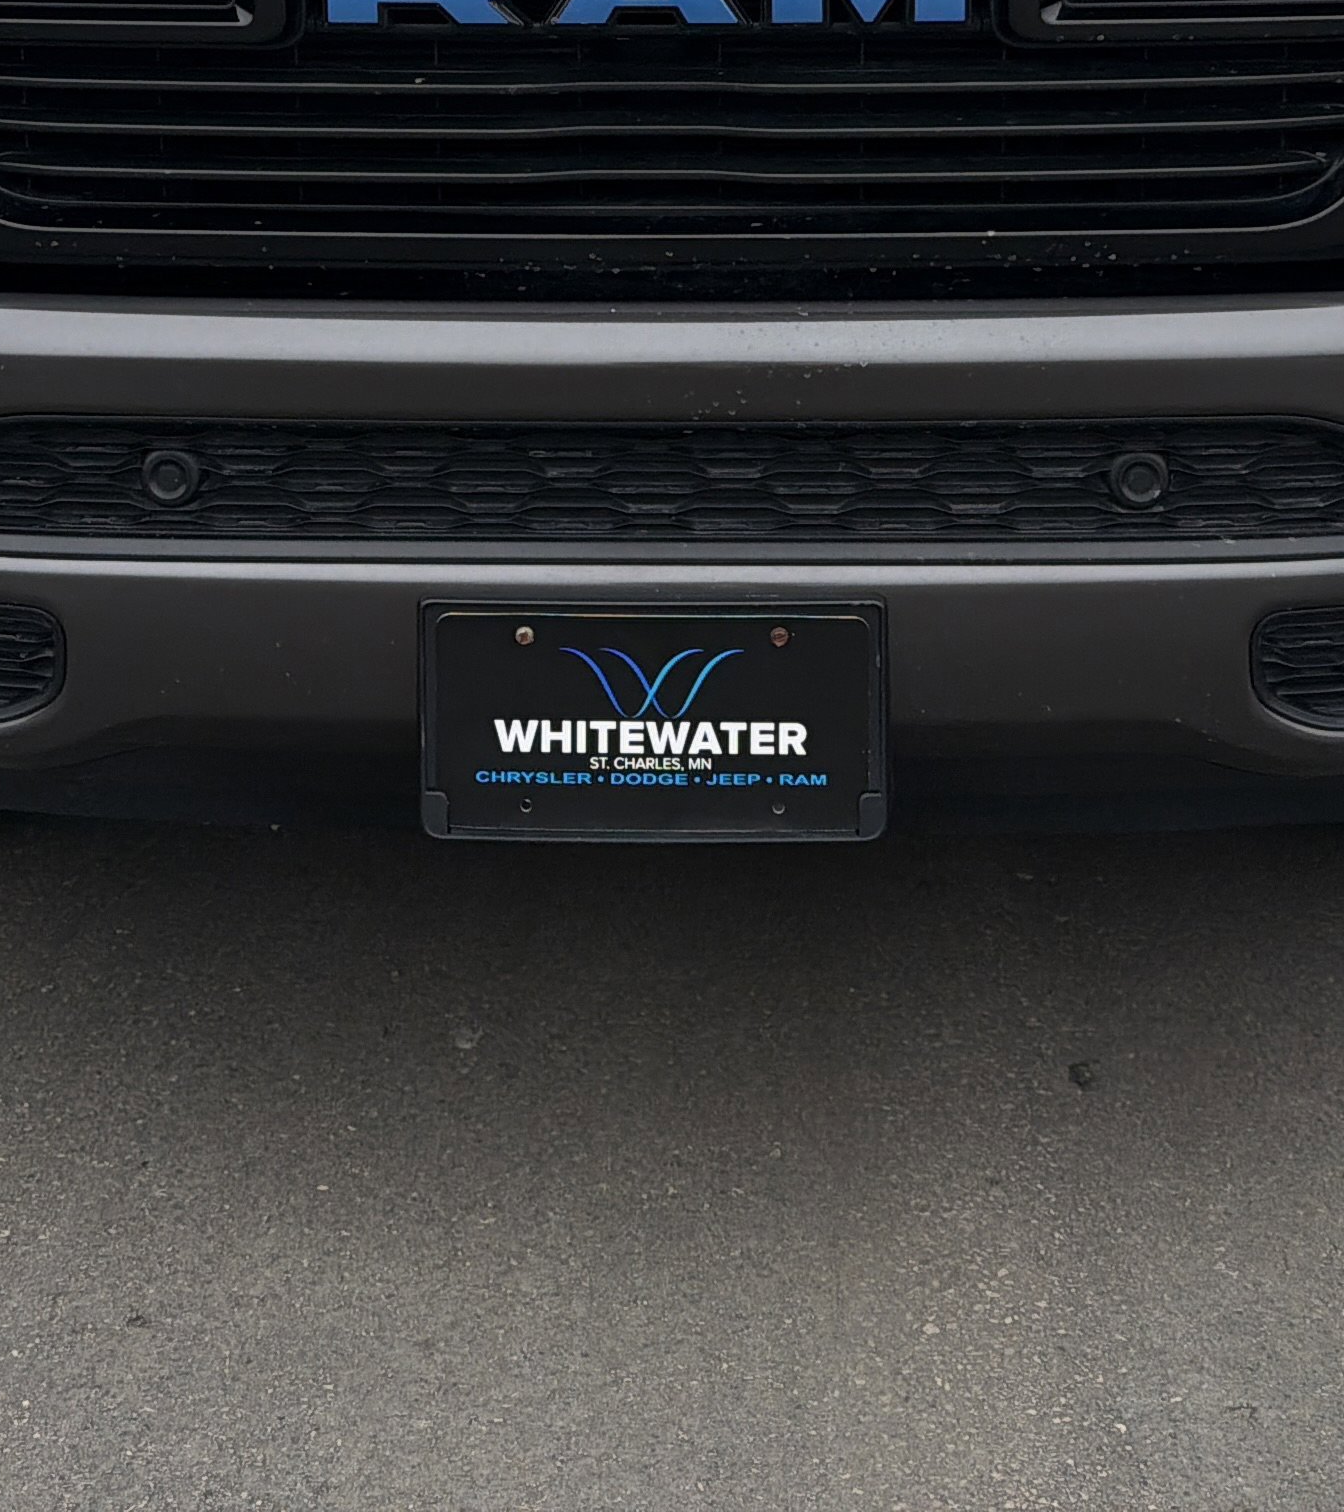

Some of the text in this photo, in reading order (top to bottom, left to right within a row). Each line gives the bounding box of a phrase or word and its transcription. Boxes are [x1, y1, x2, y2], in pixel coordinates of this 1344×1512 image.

[493, 719, 808, 756] WHITEWATER
[589, 756, 712, 771] ST. CHARLES, MN
[475, 770, 828, 786] CHRYSLER DODGE JEEP RAM
